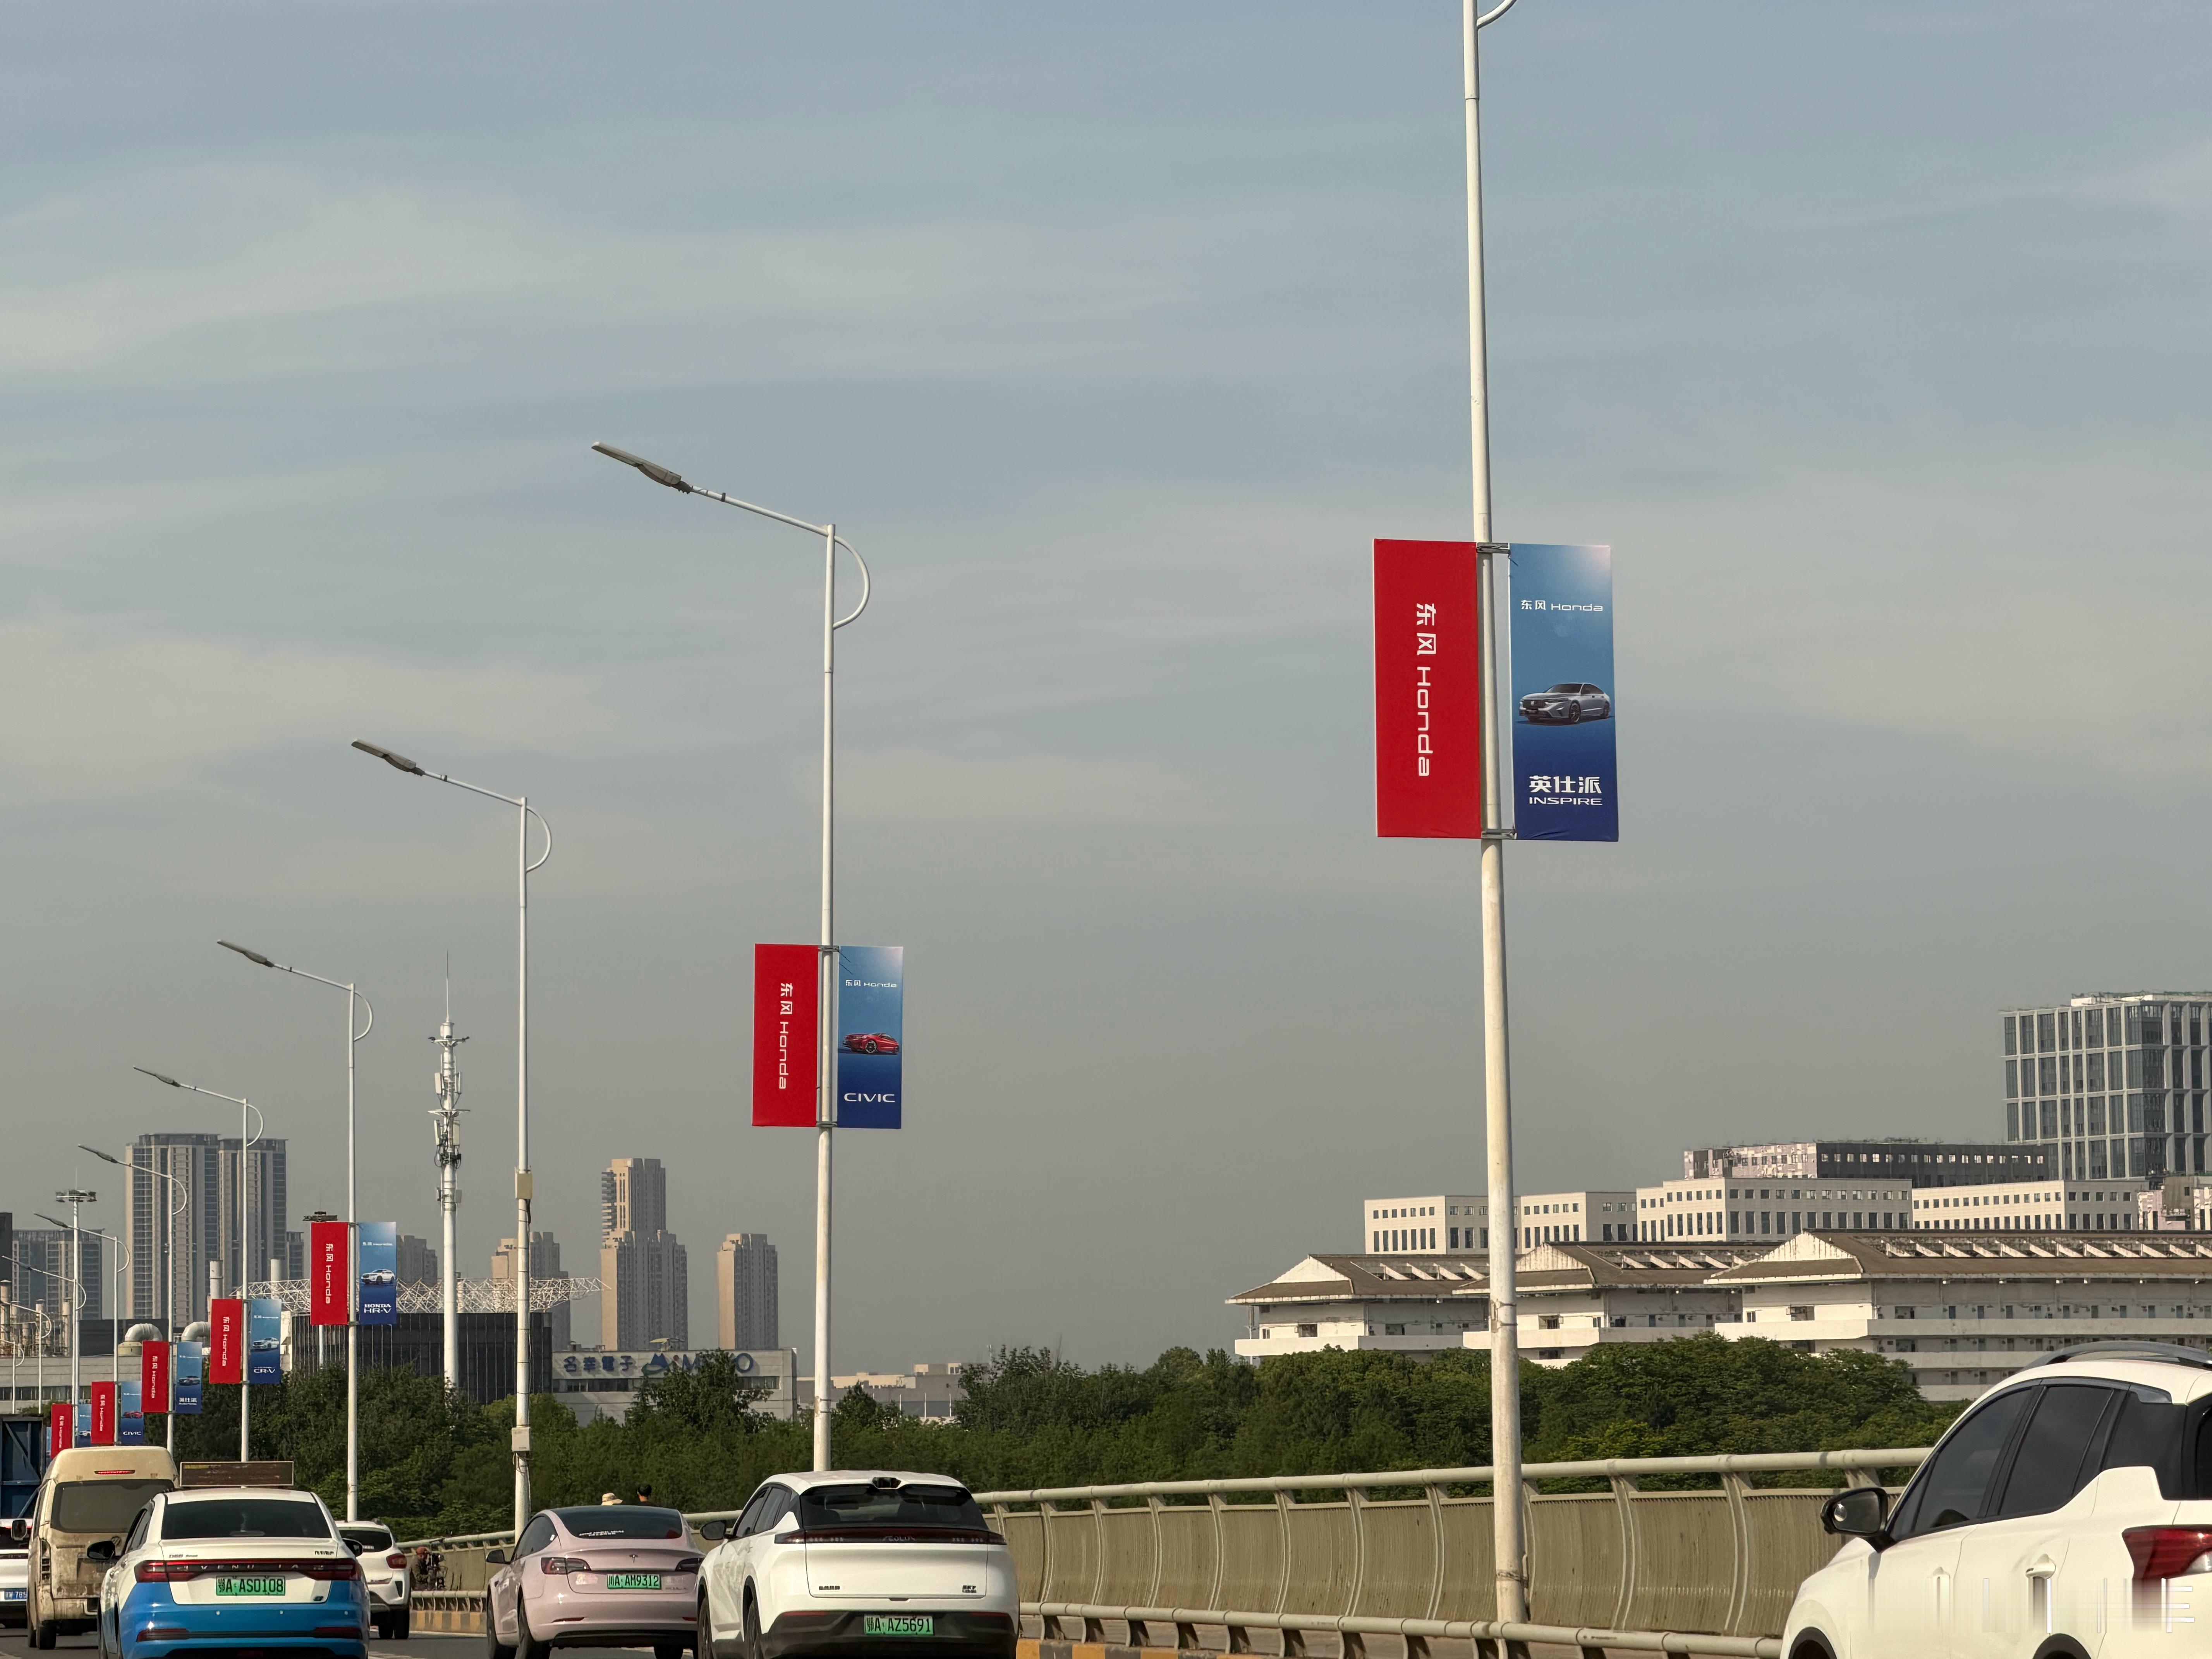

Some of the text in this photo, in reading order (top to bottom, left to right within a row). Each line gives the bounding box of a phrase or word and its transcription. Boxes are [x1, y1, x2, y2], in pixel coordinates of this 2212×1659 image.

[1522, 599, 1603, 611] 东风 Honda
[1416, 603, 1436, 776] 东风 Honda
[1529, 775, 1602, 793] 英仕派
[1529, 797, 1602, 805] INSPIRE
[779, 982, 793, 1089] 东风 Honda
[844, 1093, 895, 1103] CIVIC
